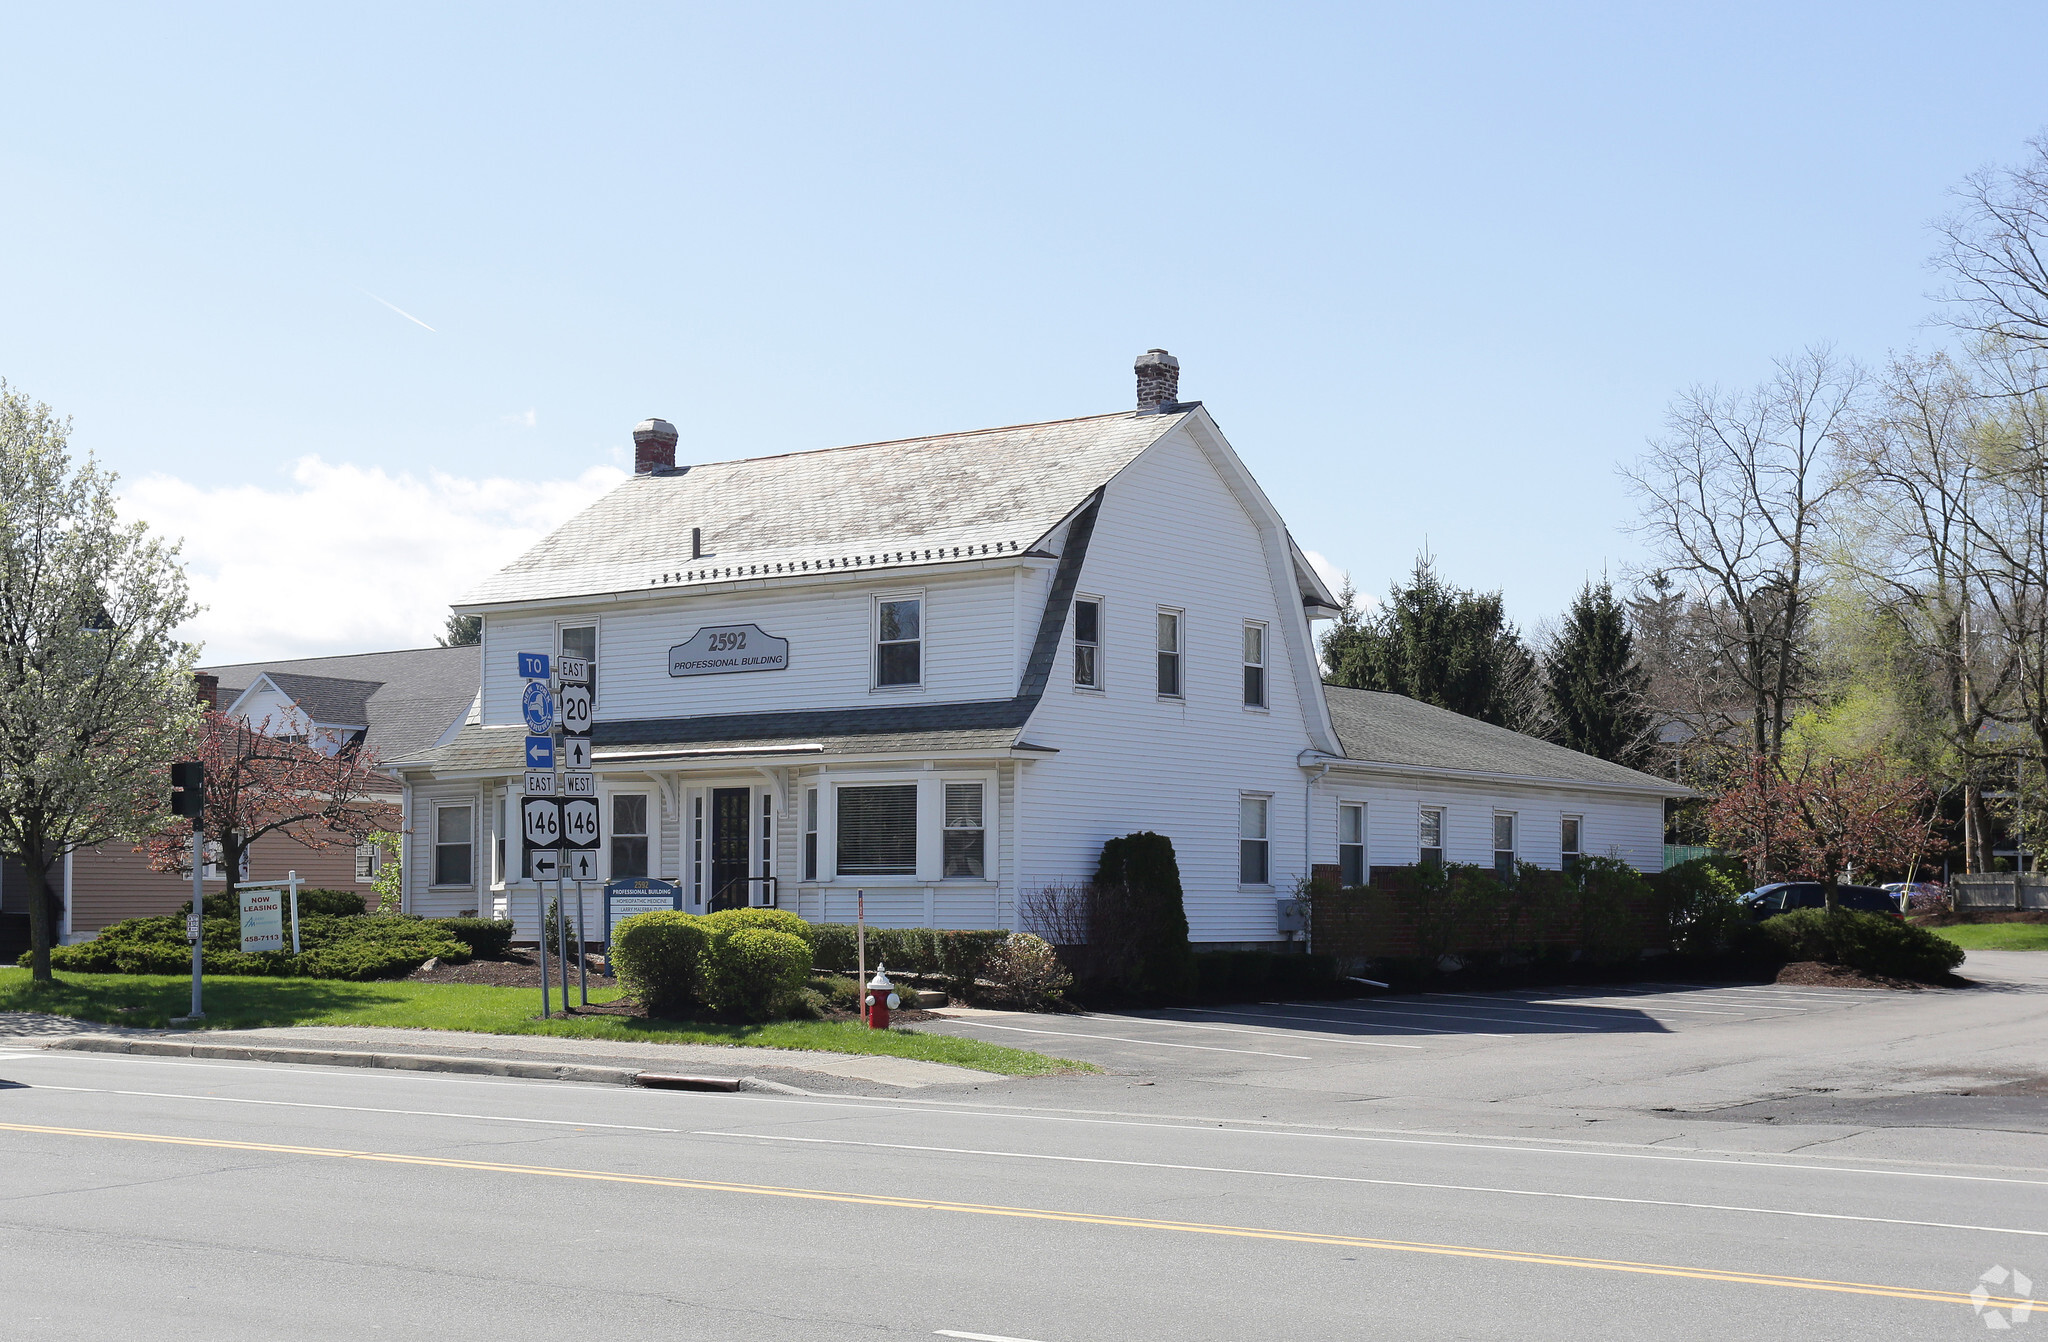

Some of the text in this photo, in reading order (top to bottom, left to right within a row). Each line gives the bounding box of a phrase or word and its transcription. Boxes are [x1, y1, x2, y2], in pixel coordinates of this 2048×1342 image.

[708, 632, 747, 651] 2592
[526, 658, 542, 674] TO
[562, 661, 584, 677] EAST
[674, 655, 783, 670] PROFESSIONAL BUILDING
[524, 684, 551, 704] NEW YORK
[566, 698, 588, 721] 20
[526, 714, 552, 731] THRUWAY
[529, 777, 552, 791] EAST
[567, 777, 590, 791] WEST
[527, 811, 557, 834] 146
[566, 811, 595, 834] 146
[634, 881, 649, 889] 2592
[243, 904, 278, 912] LEASING
[244, 934, 279, 942] 458-7113
